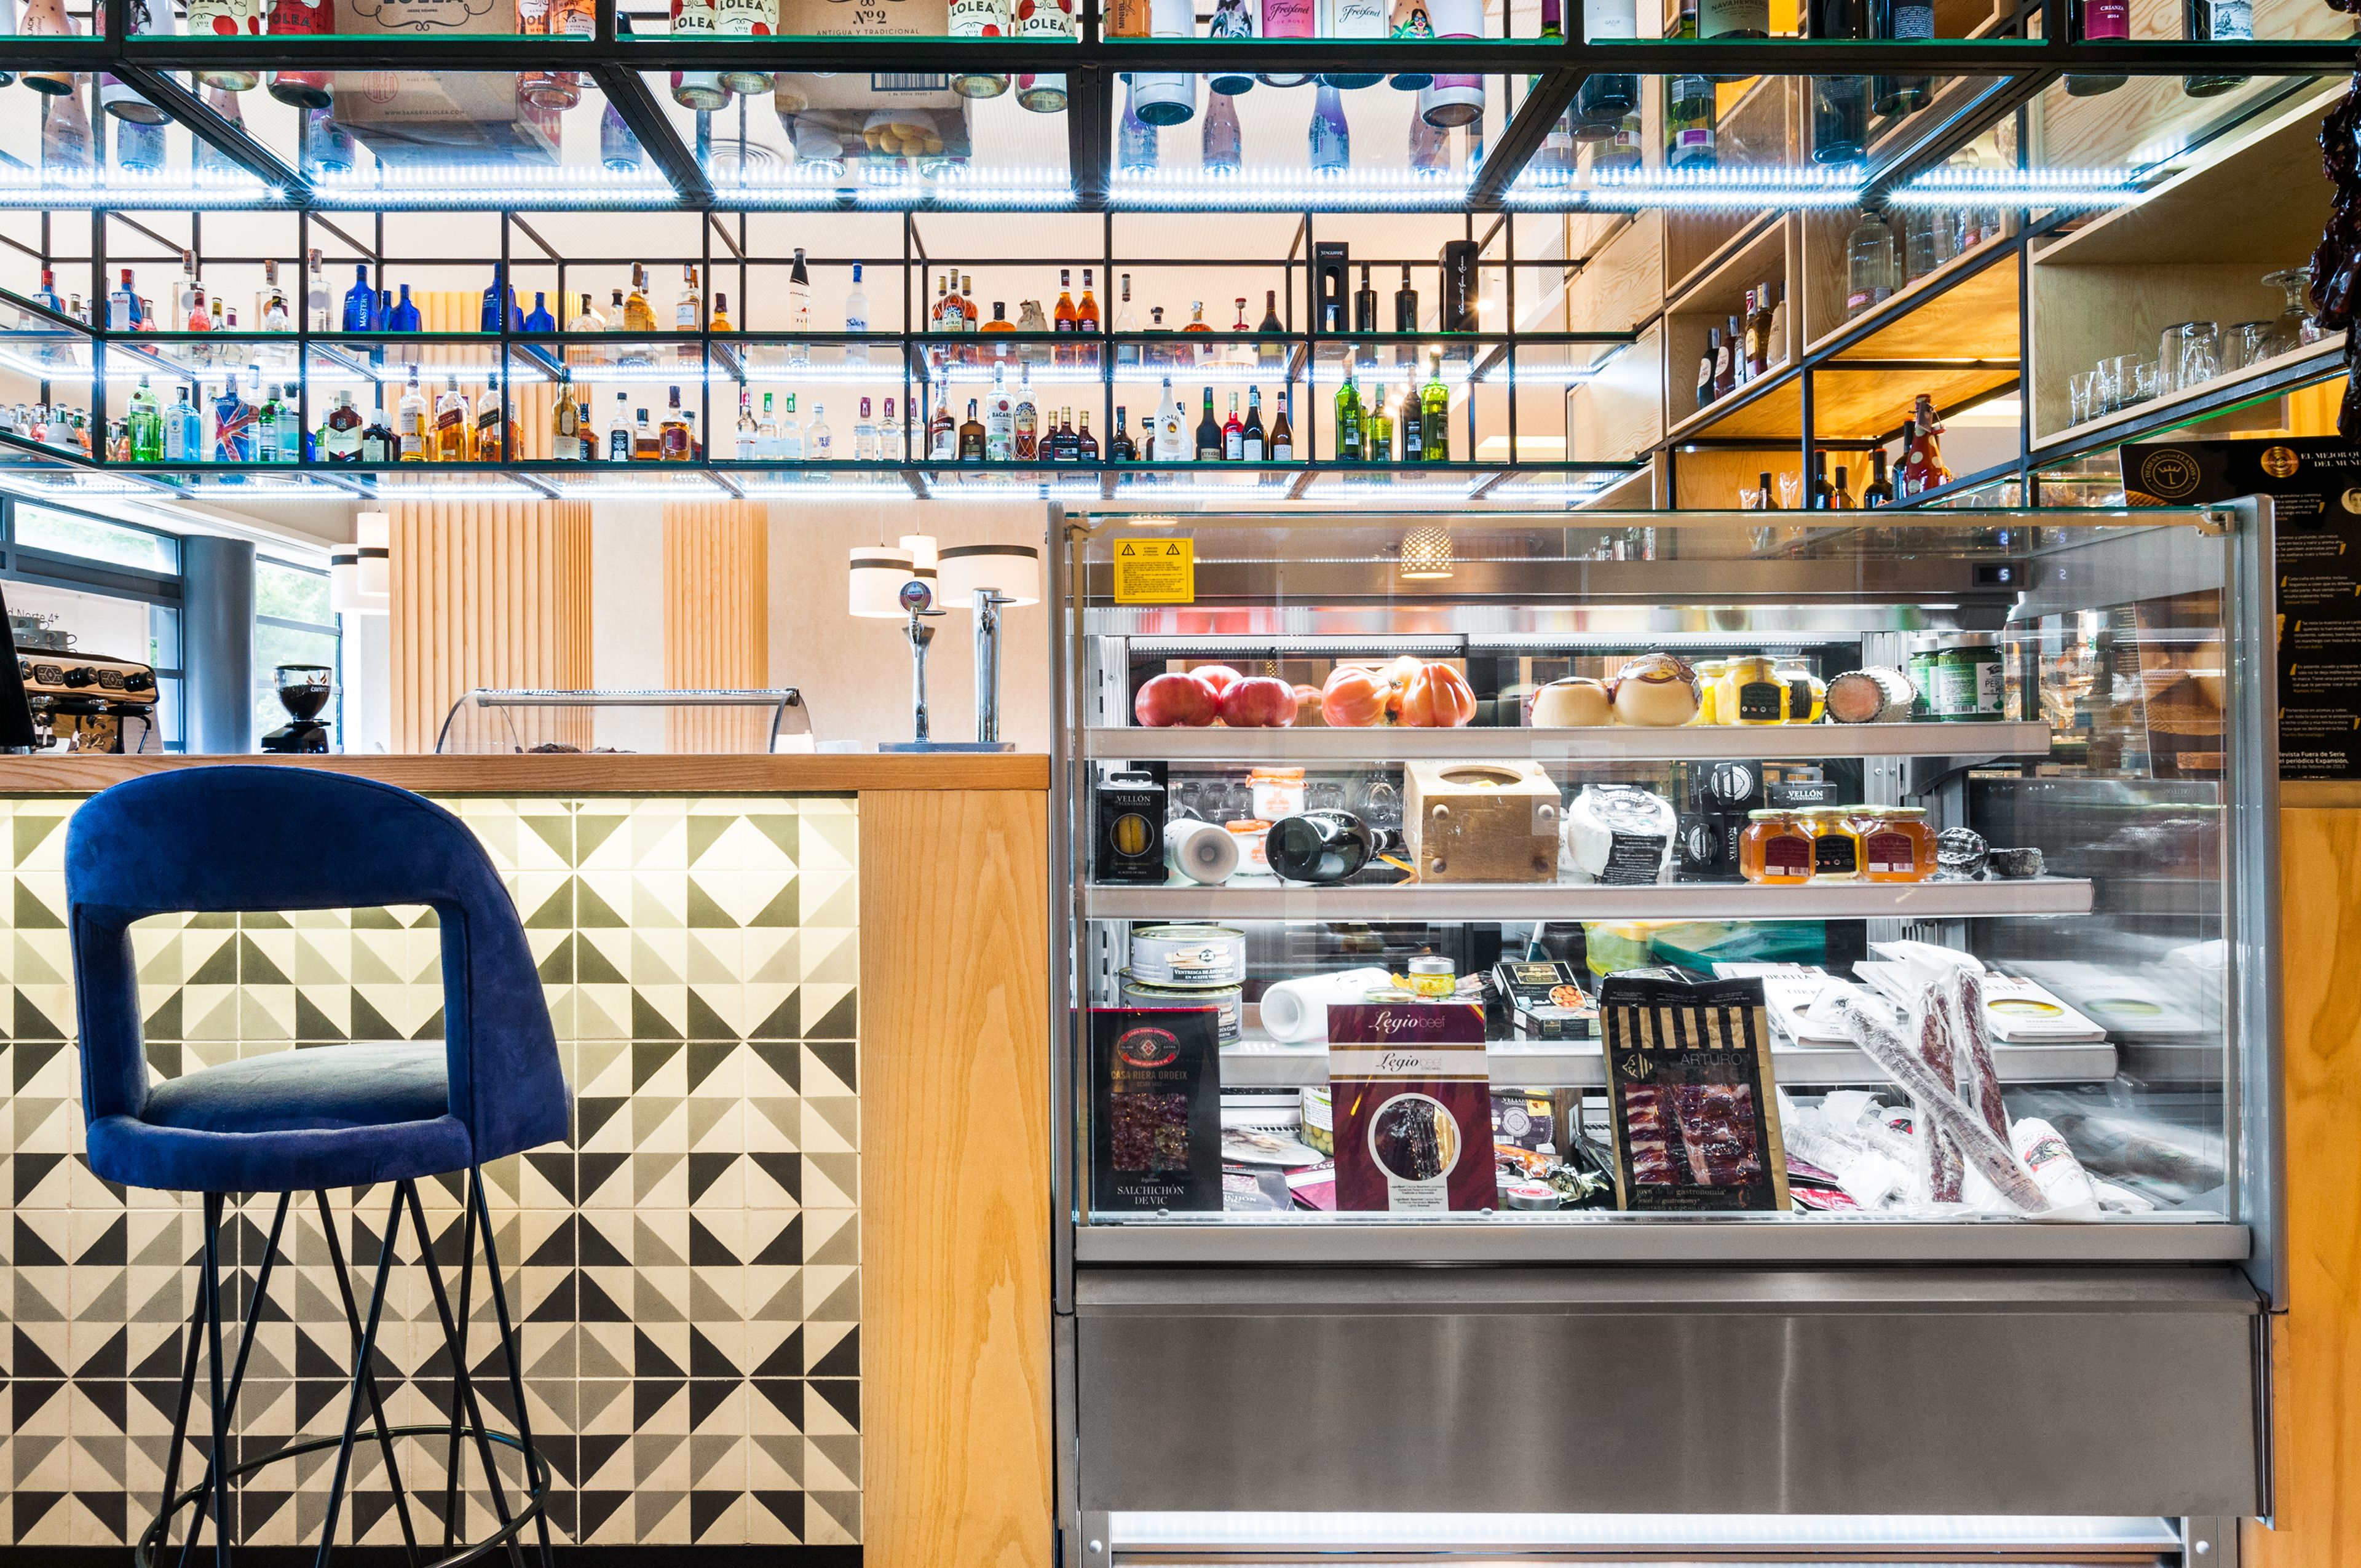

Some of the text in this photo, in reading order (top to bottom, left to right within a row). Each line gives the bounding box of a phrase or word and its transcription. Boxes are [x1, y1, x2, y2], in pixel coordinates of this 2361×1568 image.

[952, 0, 995, 17] LOLEA
[1267, 3, 1310, 22] Freixenet
[1339, 5, 1382, 23] Freixenet
[673, 17, 716, 30] LOLEA
[1022, 18, 1067, 32] LOLEA
[1788, 789, 1824, 798] VELLÓN
[1680, 1053, 1742, 1066] ARTURO
[1111, 1071, 1188, 1080] CASA RIERA ORDEIX
[1117, 1184, 1184, 1195] SALCHICHÓN
[1134, 1196, 1168, 1205] DE VIC
